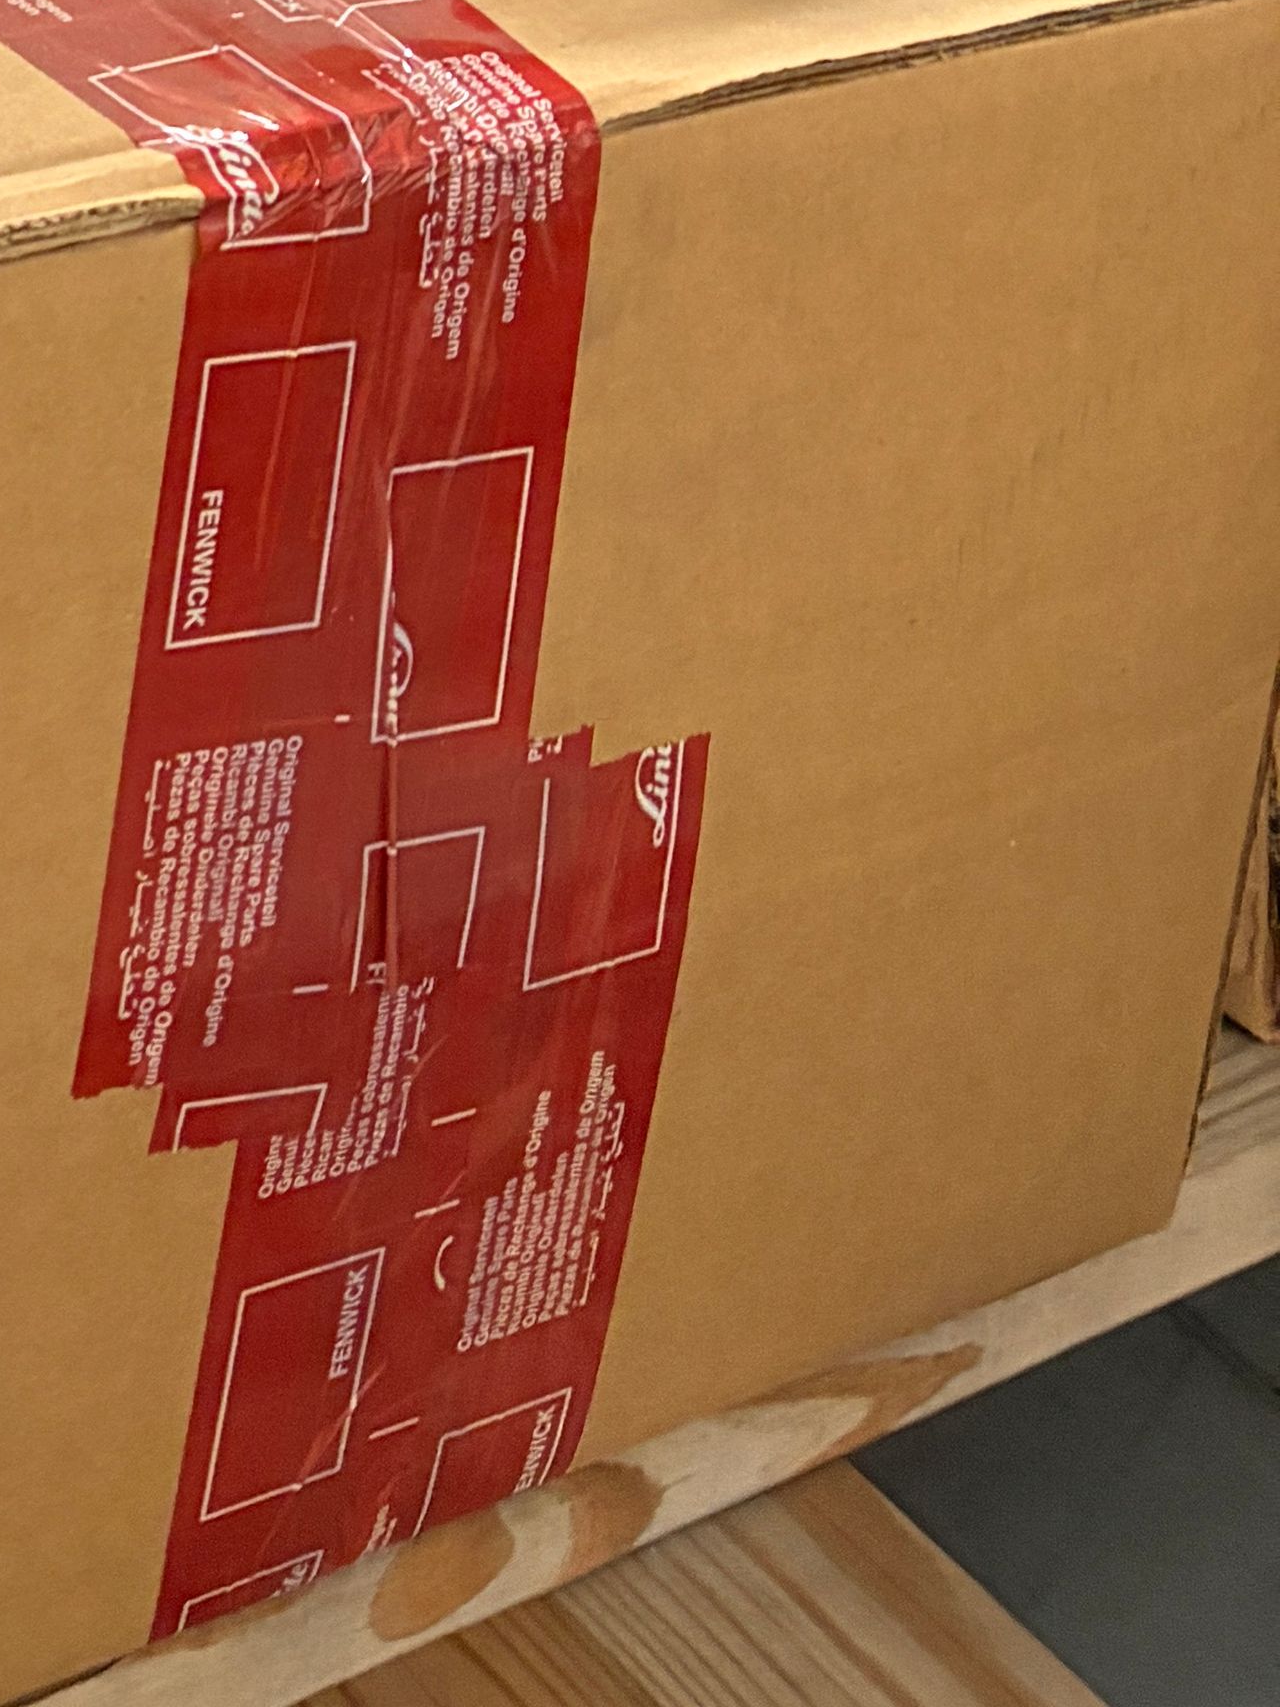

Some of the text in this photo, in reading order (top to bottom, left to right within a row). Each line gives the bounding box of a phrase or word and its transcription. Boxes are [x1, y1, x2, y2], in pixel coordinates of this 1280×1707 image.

[479, 50, 541, 100] Original
[431, 266, 454, 339] Origen
[444, 237, 457, 261] de
[501, 227, 528, 324] d'Origine
[445, 251, 471, 361] de Origem
[183, 488, 224, 630] FENWICK
[203, 742, 248, 925] Ricambi Originali
[234, 813, 256, 845] de
[236, 736, 286, 949] Genuine Spare Parts
[258, 734, 302, 929] Original Serviceteil
[125, 751, 191, 1067] Piezas de Recambio de Origen
[142, 748, 210, 1087] Peças sobressalentes de Origem
[180, 845, 216, 970] Onderdelen
[217, 845, 250, 951] Rechange
[201, 952, 233, 1049] d'Origine
[582, 1046, 606, 1117] Origem
[330, 1265, 368, 1380] FENWICK
[516, 1408, 555, 1493] ENWICK
